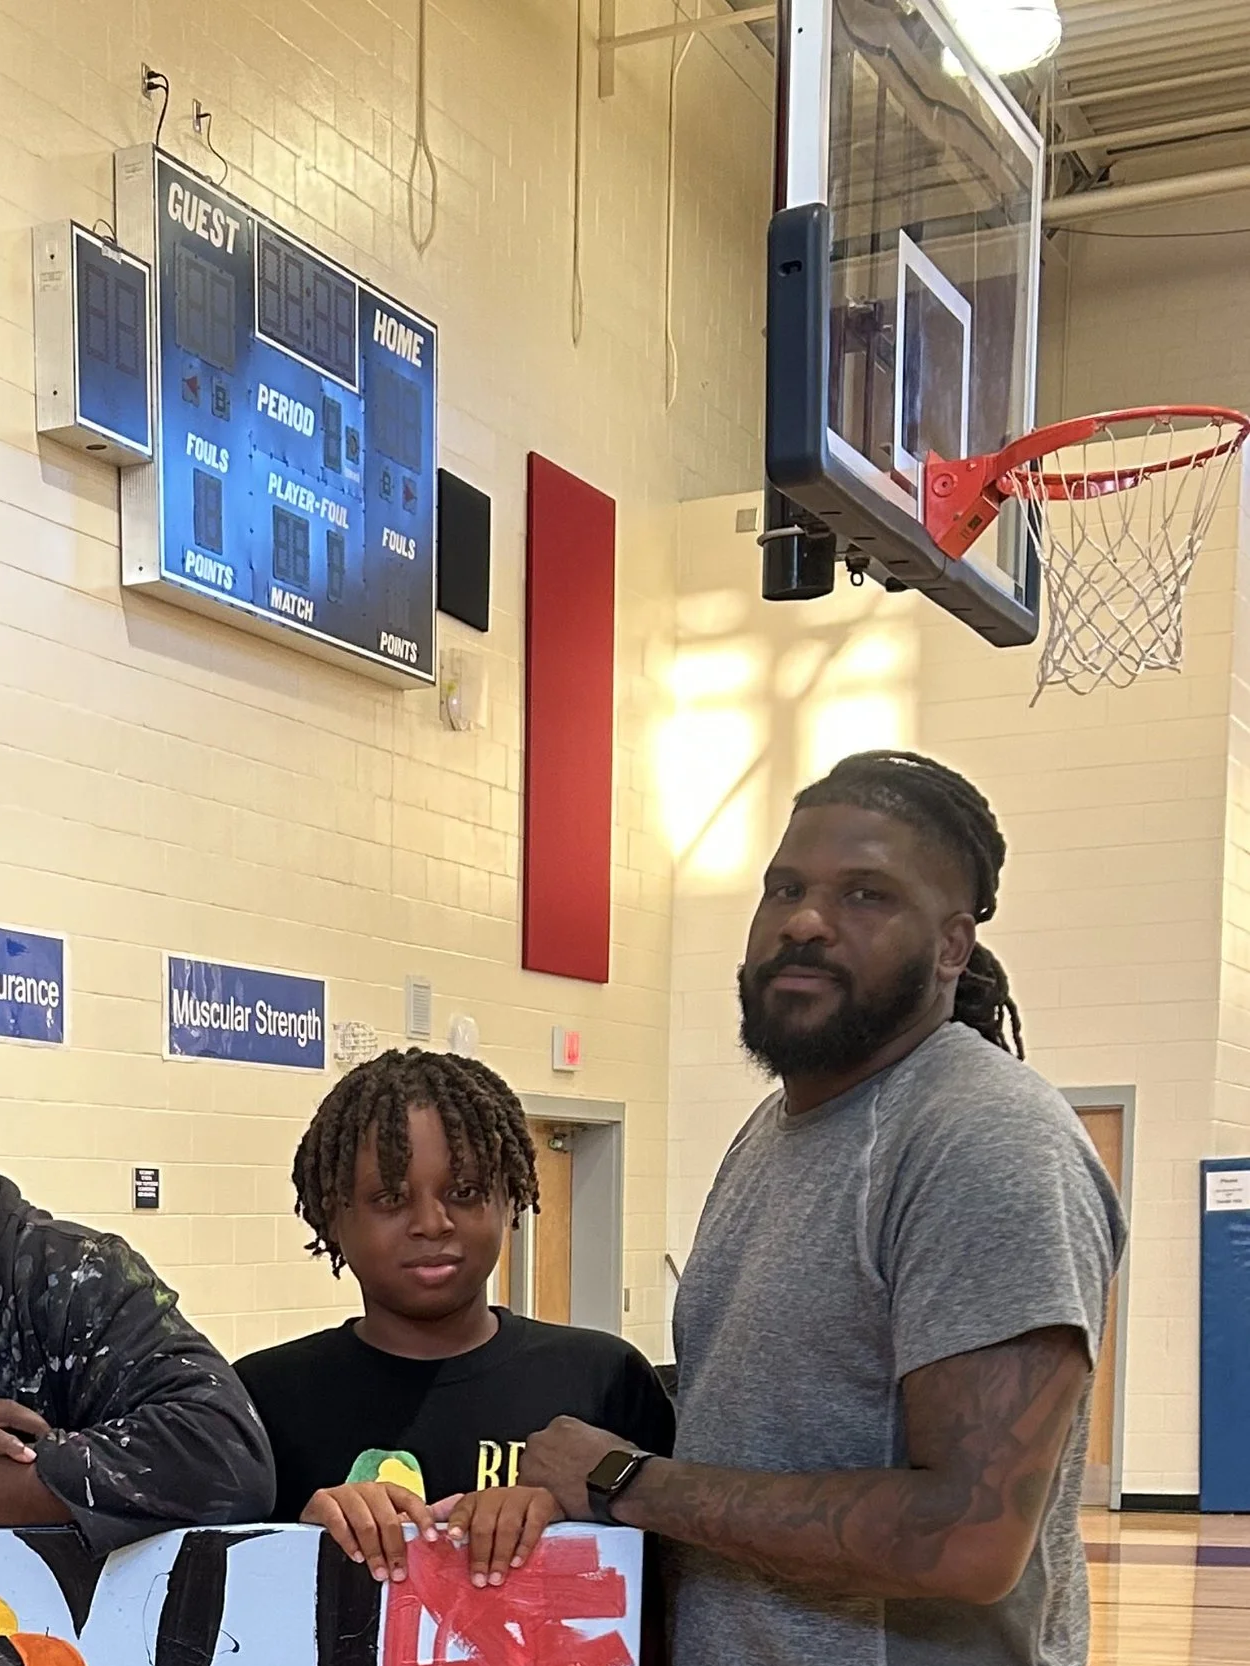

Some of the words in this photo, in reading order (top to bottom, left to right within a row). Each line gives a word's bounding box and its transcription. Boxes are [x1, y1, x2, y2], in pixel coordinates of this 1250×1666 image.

[167, 182, 240, 254] GUEST
[373, 309, 424, 368] HOME
[257, 382, 315, 437] PERIOD
[186, 431, 230, 473] FOULS
[268, 471, 349, 529] PLAYER-FOUL
[382, 526, 416, 560] FOULS
[185, 550, 234, 590] POINTS
[269, 587, 313, 622] MATCH
[380, 631, 418, 664] POINTS
[172, 988, 252, 1033] Muscular
[254, 1000, 322, 1048] Strength
